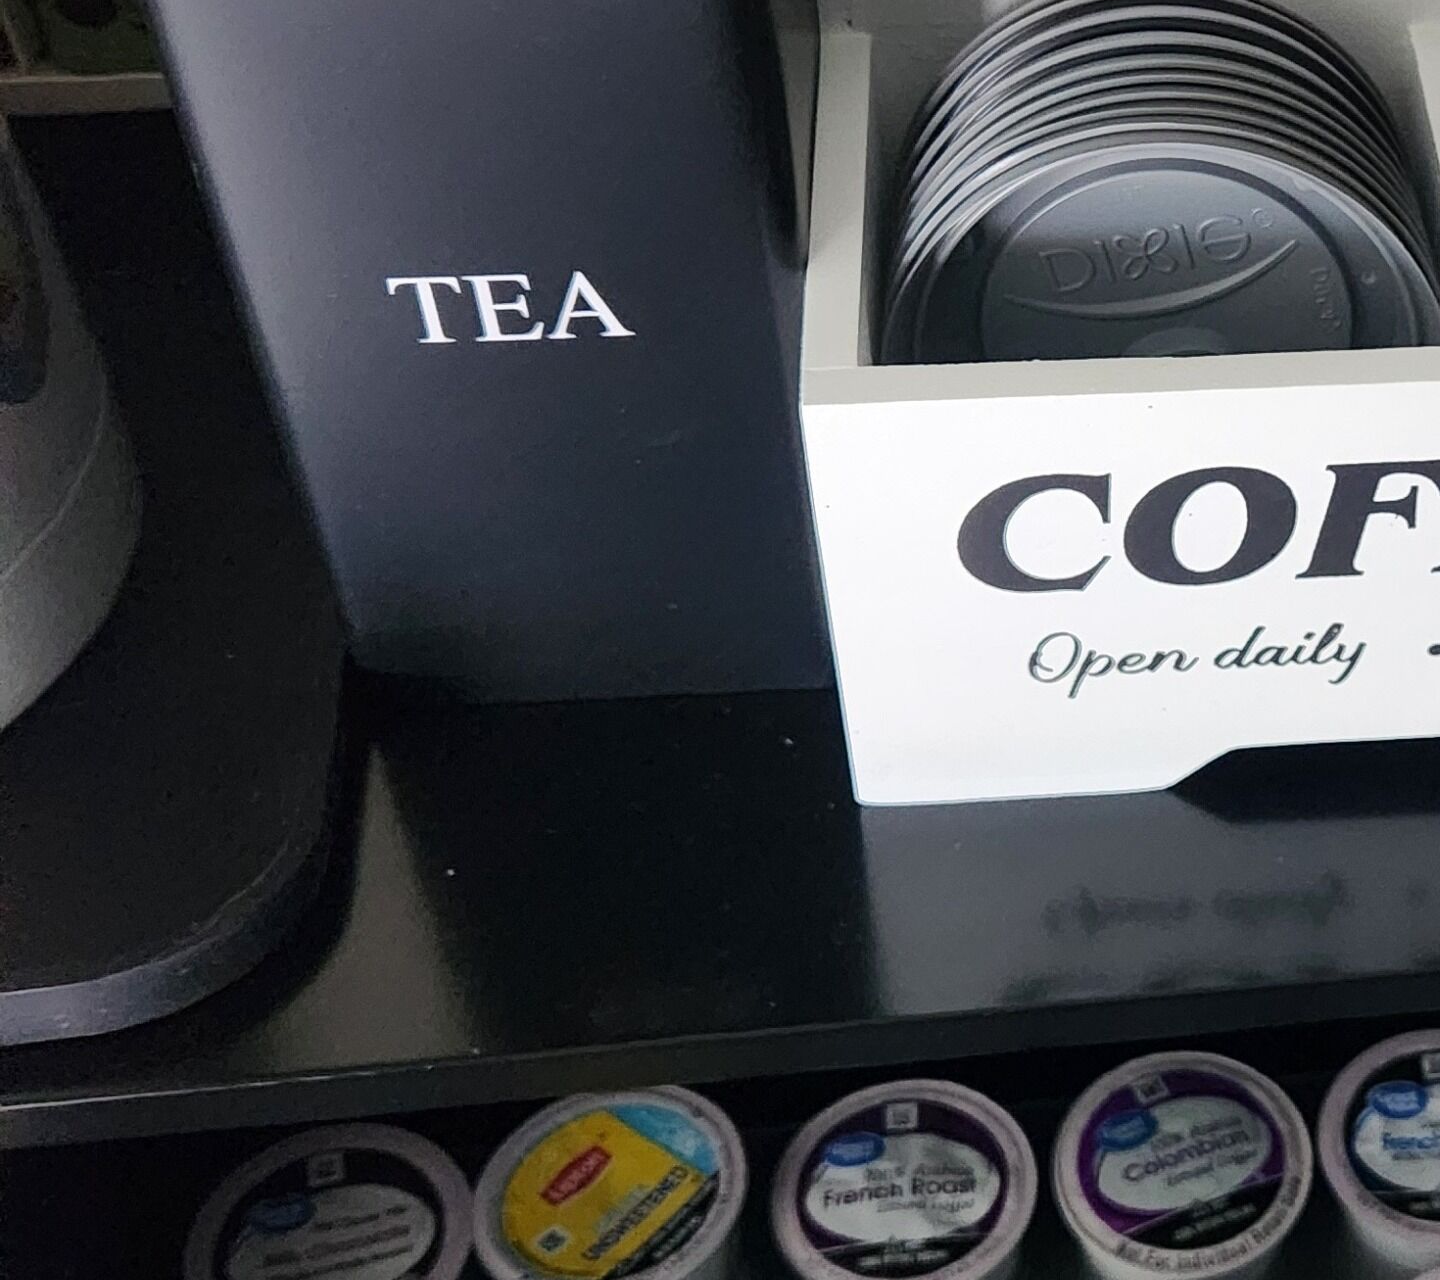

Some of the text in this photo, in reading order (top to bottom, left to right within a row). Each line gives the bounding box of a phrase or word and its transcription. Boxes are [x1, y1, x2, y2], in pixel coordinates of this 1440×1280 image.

[385, 270, 637, 344] TEA
[1028, 622, 1368, 699] Open daily
